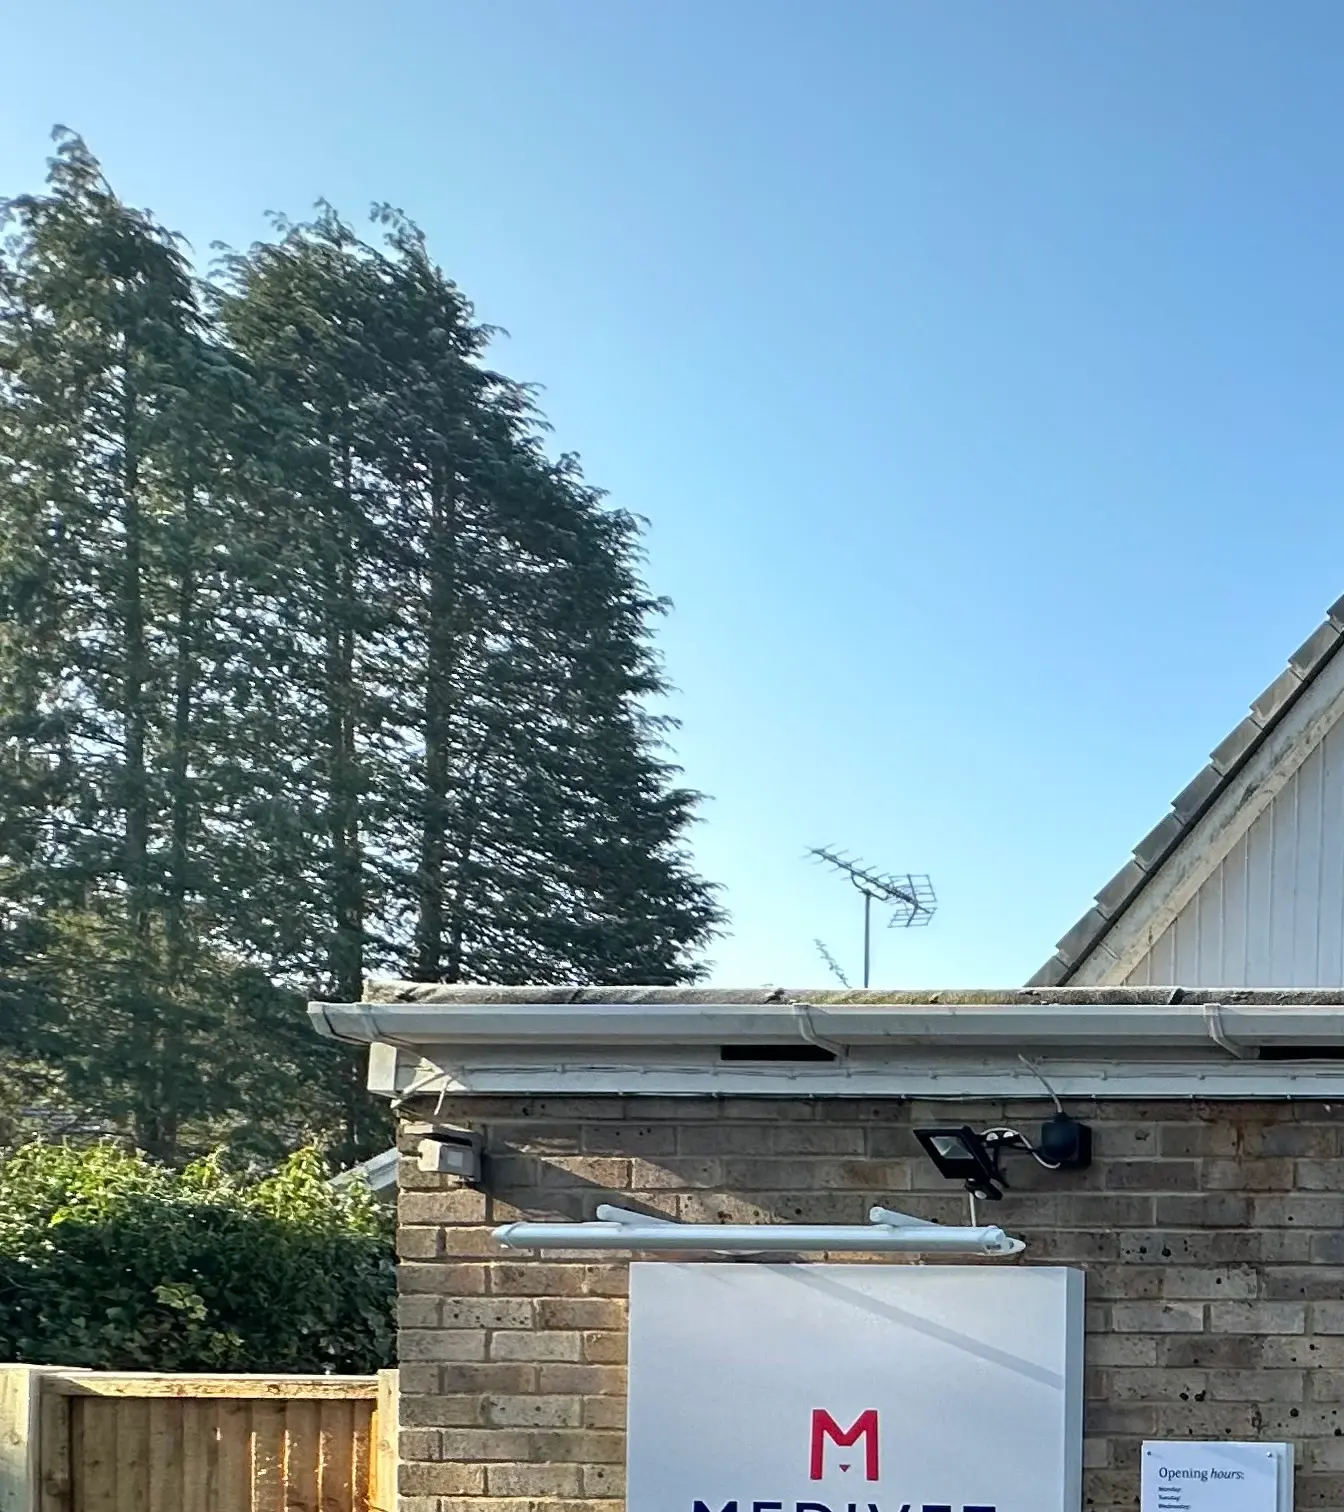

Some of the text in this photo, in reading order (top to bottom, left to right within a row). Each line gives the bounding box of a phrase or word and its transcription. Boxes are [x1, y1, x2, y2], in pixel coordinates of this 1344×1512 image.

[810, 1409, 879, 1481] M
[1159, 1467, 1245, 1482] Opening hours:
